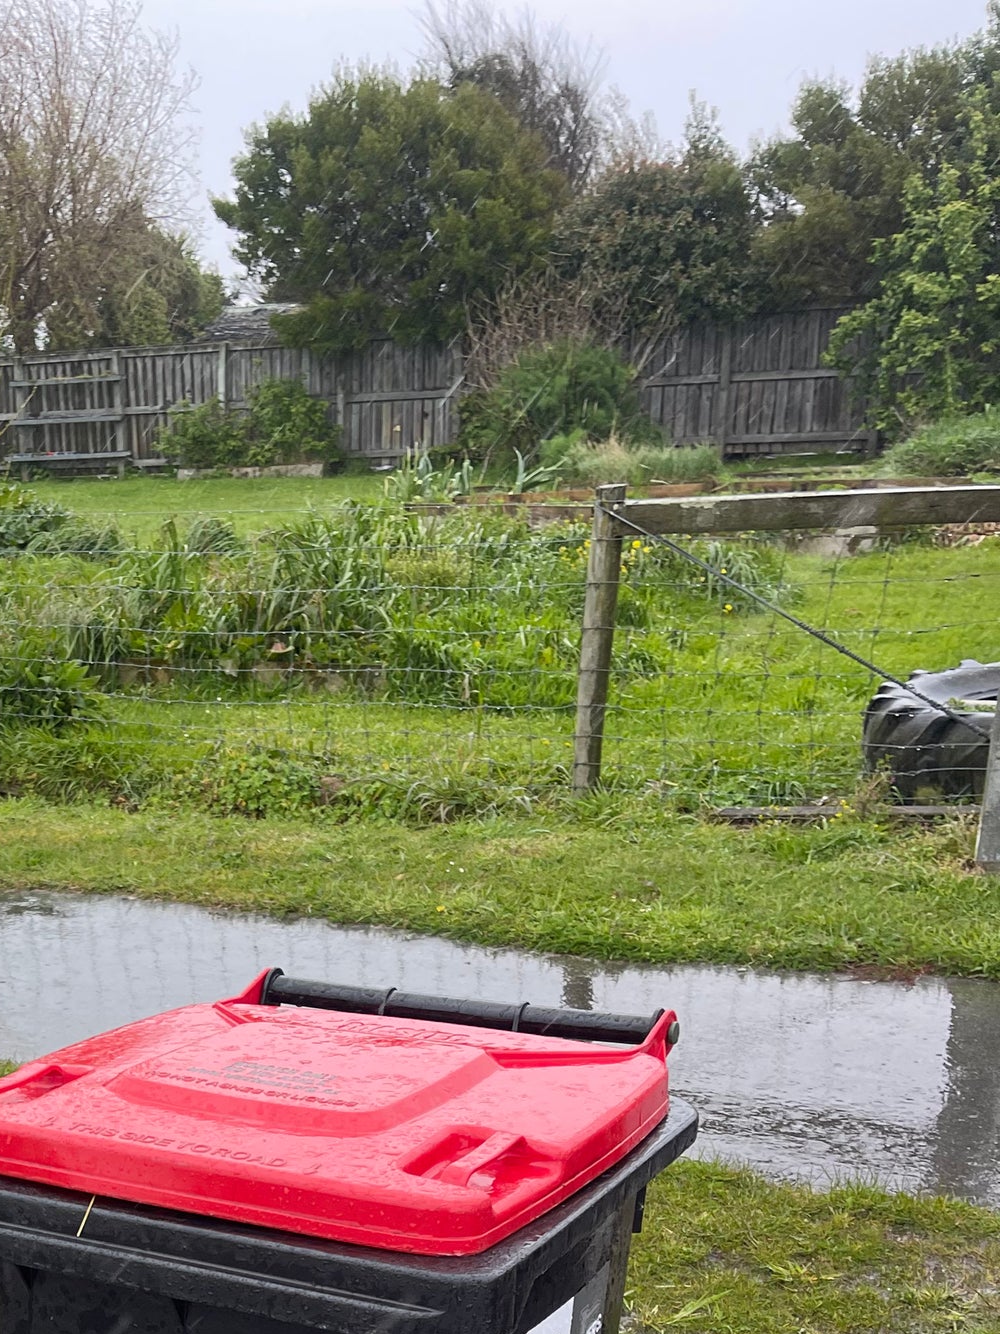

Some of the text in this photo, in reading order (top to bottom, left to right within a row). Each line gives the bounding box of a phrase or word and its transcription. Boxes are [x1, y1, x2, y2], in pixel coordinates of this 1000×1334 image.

[69, 1122, 288, 1169] THIS SIDE TO ROAD
